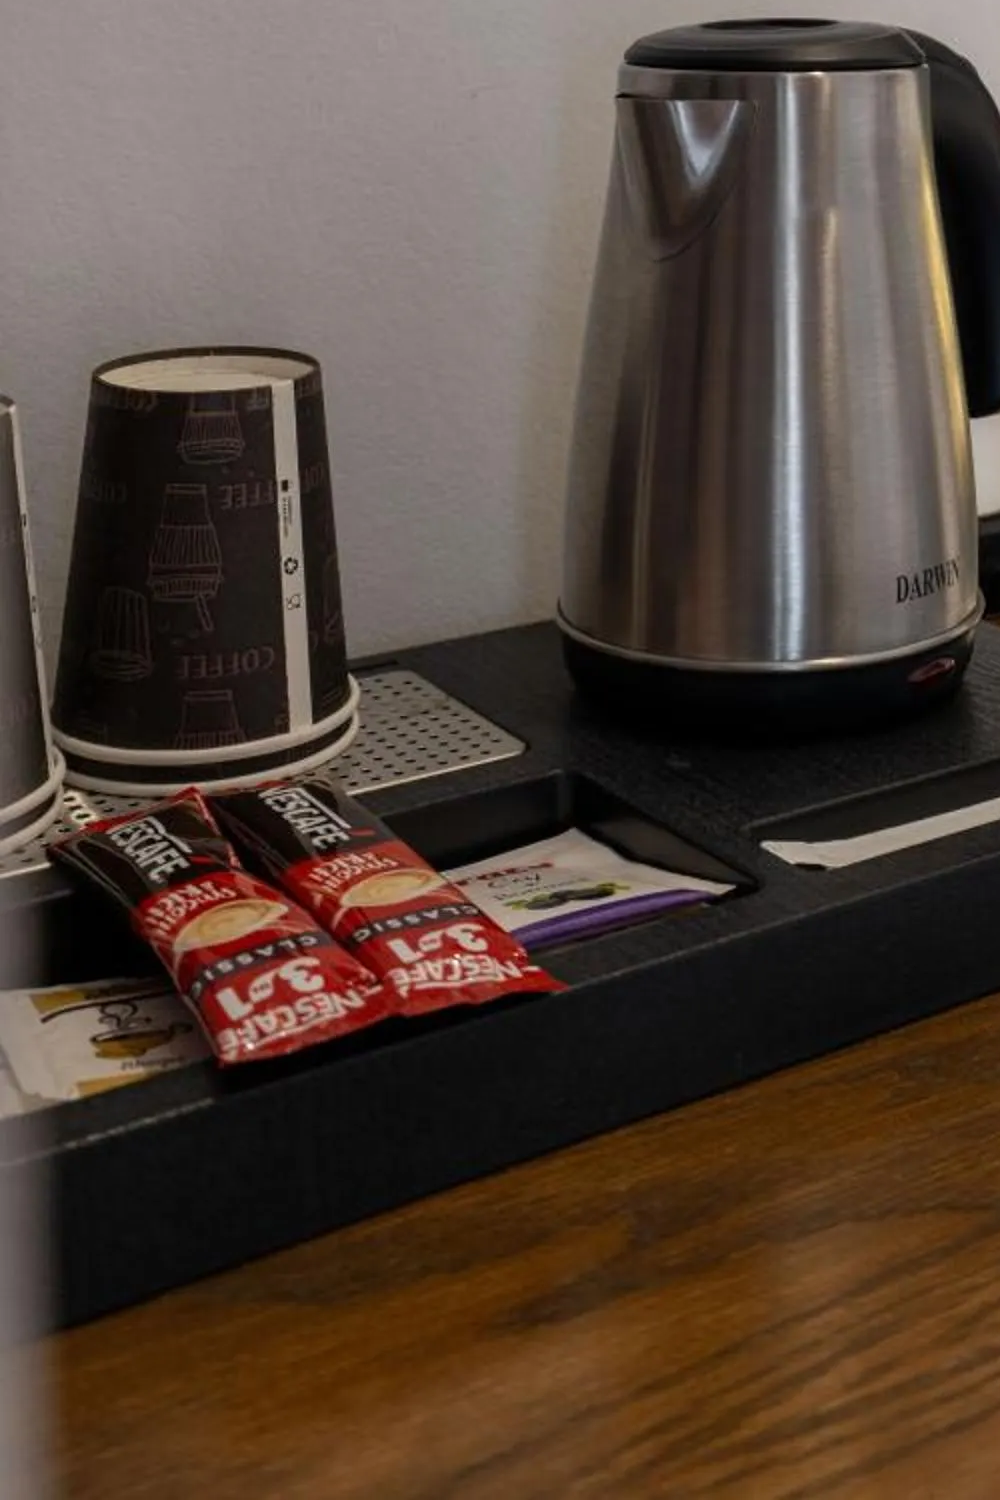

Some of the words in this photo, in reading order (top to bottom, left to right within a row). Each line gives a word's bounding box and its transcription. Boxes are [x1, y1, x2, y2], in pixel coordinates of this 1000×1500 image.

[895, 558, 961, 604] DARWIN
[174, 646, 274, 680] COFFEE
[352, 905, 481, 943] CLASSIC
[387, 953, 530, 1000] NESCAFÉ
[215, 984, 374, 1061] NESCAFÉ
